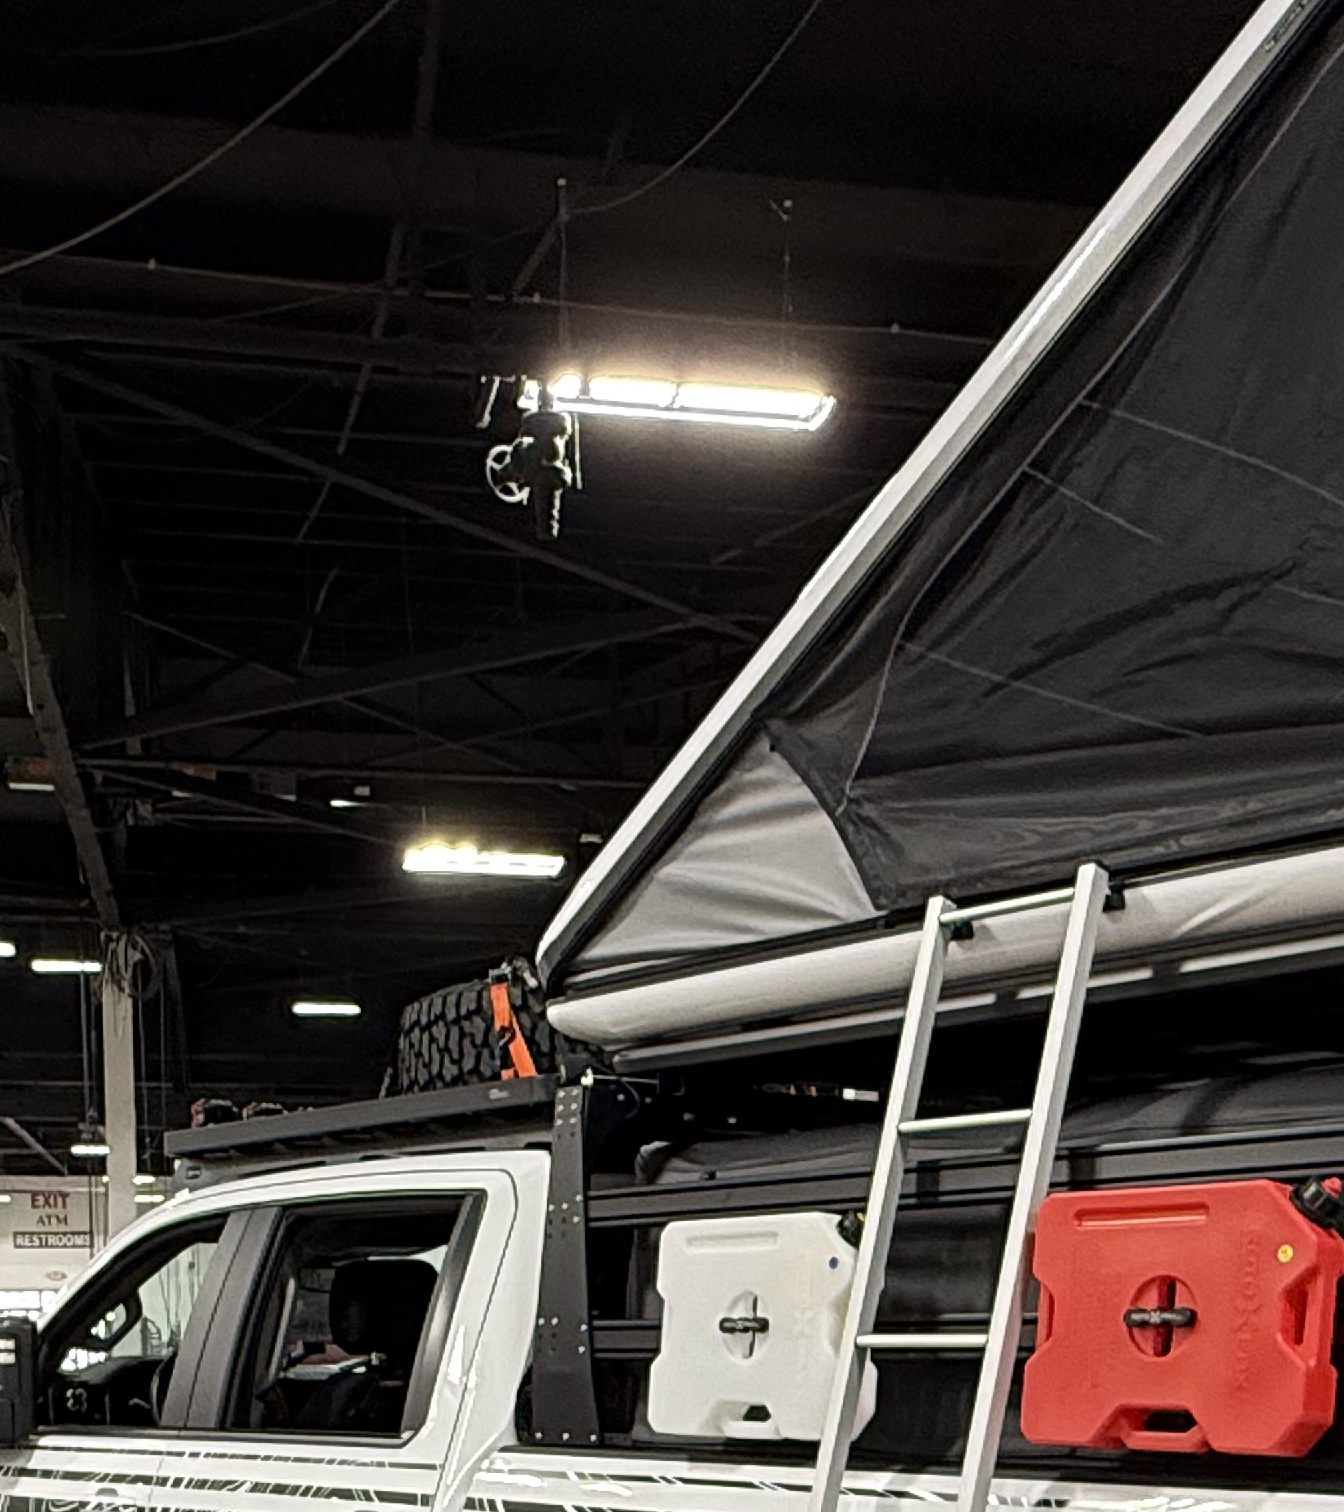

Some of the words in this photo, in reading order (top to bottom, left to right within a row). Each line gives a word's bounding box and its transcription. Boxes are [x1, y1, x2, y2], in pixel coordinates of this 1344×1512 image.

[30, 1191, 70, 1210] EXIT
[36, 1213, 68, 1227] ATM
[15, 1233, 91, 1247] RESTROOMS
